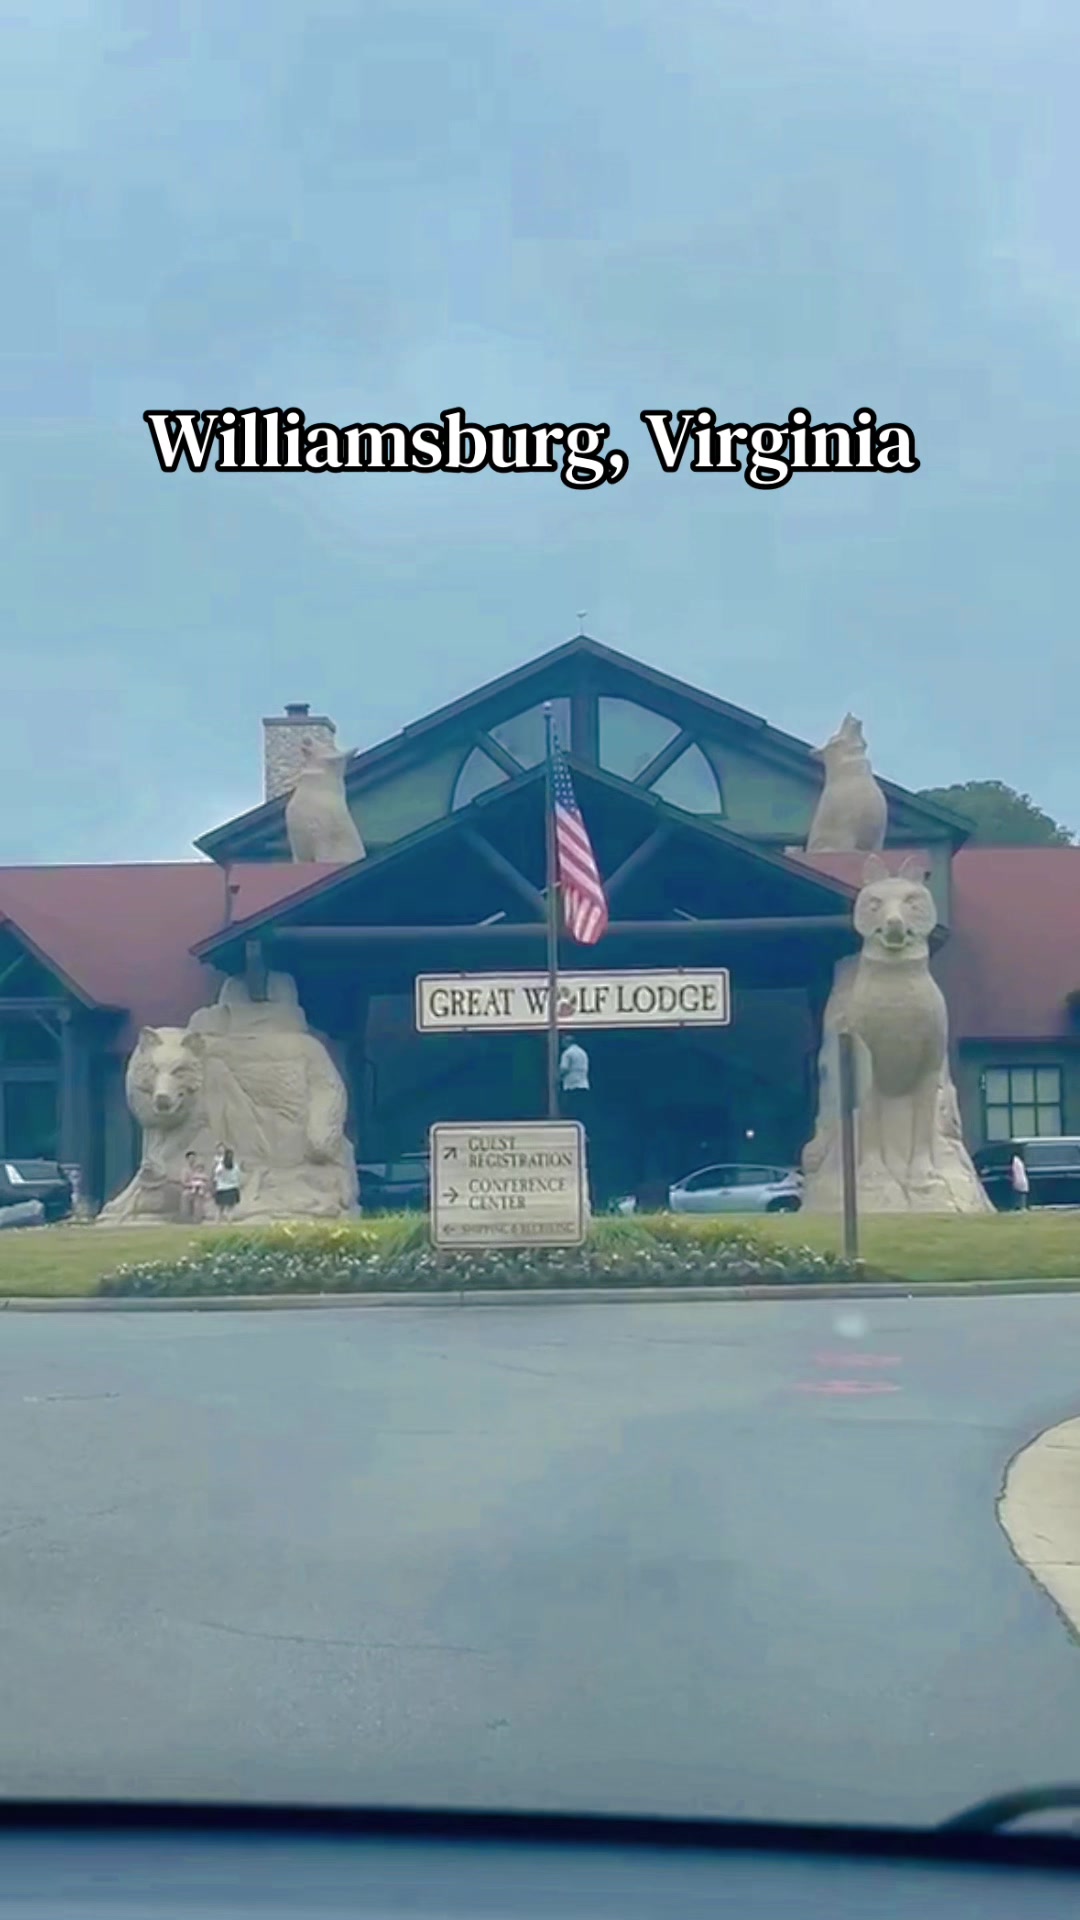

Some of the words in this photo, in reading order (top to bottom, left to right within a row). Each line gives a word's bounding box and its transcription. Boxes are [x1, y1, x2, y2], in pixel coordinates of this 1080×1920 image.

[429, 988, 514, 1018] GREAT
[617, 984, 718, 1013] LODGE
[468, 1136, 516, 1151] GUEST
[468, 1152, 573, 1168] REGISTRATION
[468, 1178, 566, 1193] CONFERENCE
[468, 1195, 526, 1210] CENTER
